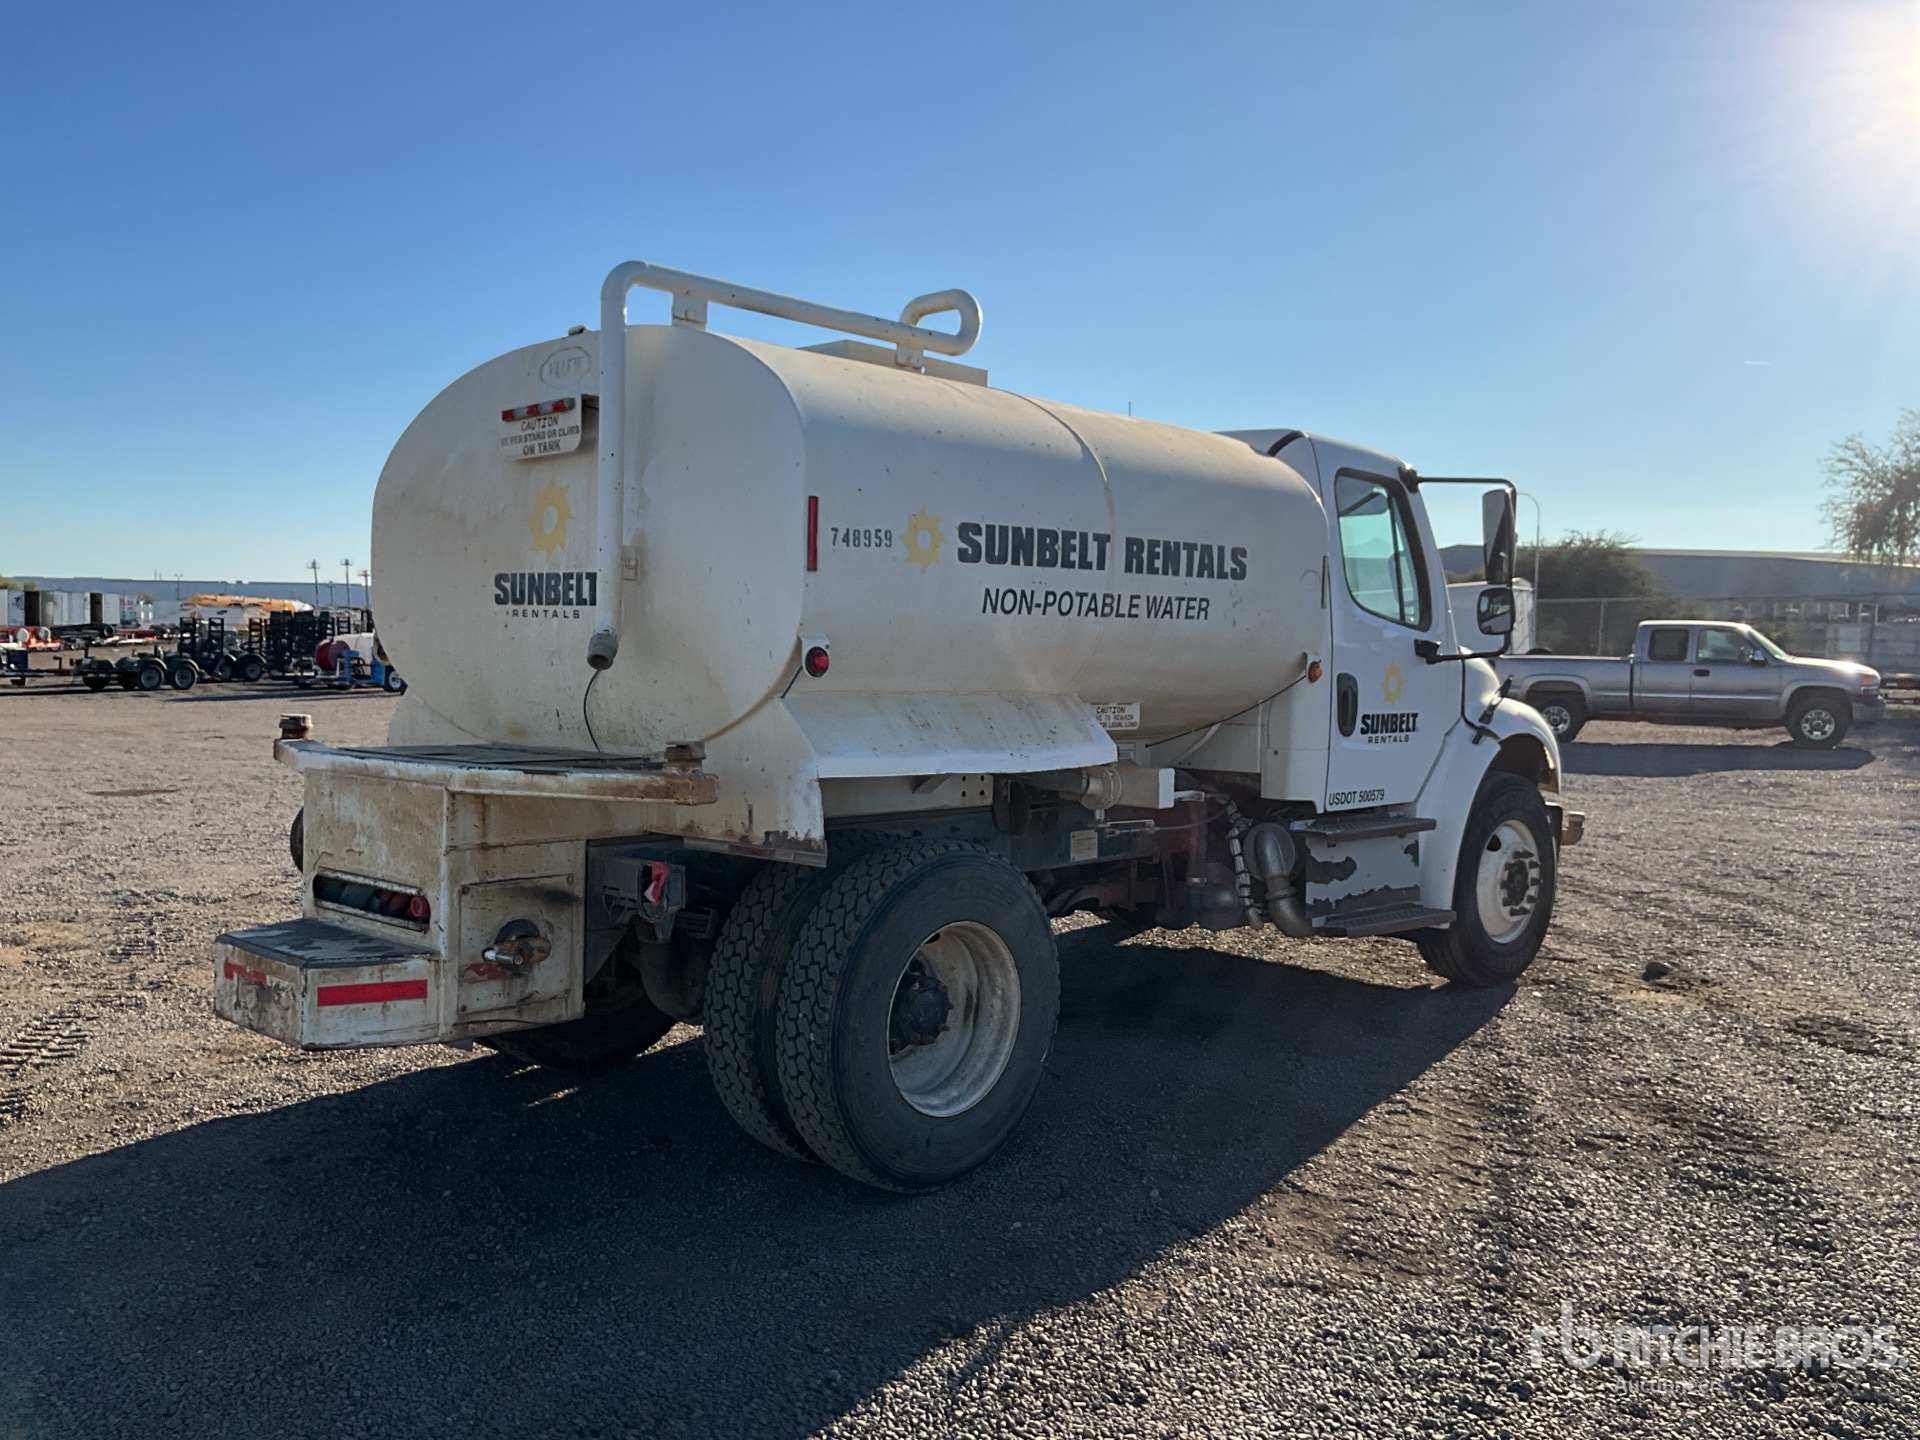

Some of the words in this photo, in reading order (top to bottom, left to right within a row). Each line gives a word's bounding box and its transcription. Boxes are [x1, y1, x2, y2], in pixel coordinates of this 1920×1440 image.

[521, 416, 559, 431] CAUTION
[547, 429, 557, 439] OR
[522, 444, 535, 456] ON
[538, 439, 561, 453] TANK
[831, 527, 893, 548] 748959
[957, 521, 1111, 571] SUNBELT
[1124, 536, 1248, 581] RENTALS
[494, 571, 598, 607] SUNBELT
[981, 587, 1141, 619] NON-POTABLE
[1146, 595, 1210, 620] WATER
[511, 609, 581, 619] RENTALS
[1360, 712, 1419, 735] SUNBELT
[1367, 734, 1410, 744] RENTALS
[1328, 791, 1357, 806] USDOT
[1358, 788, 1385, 803] 500579
